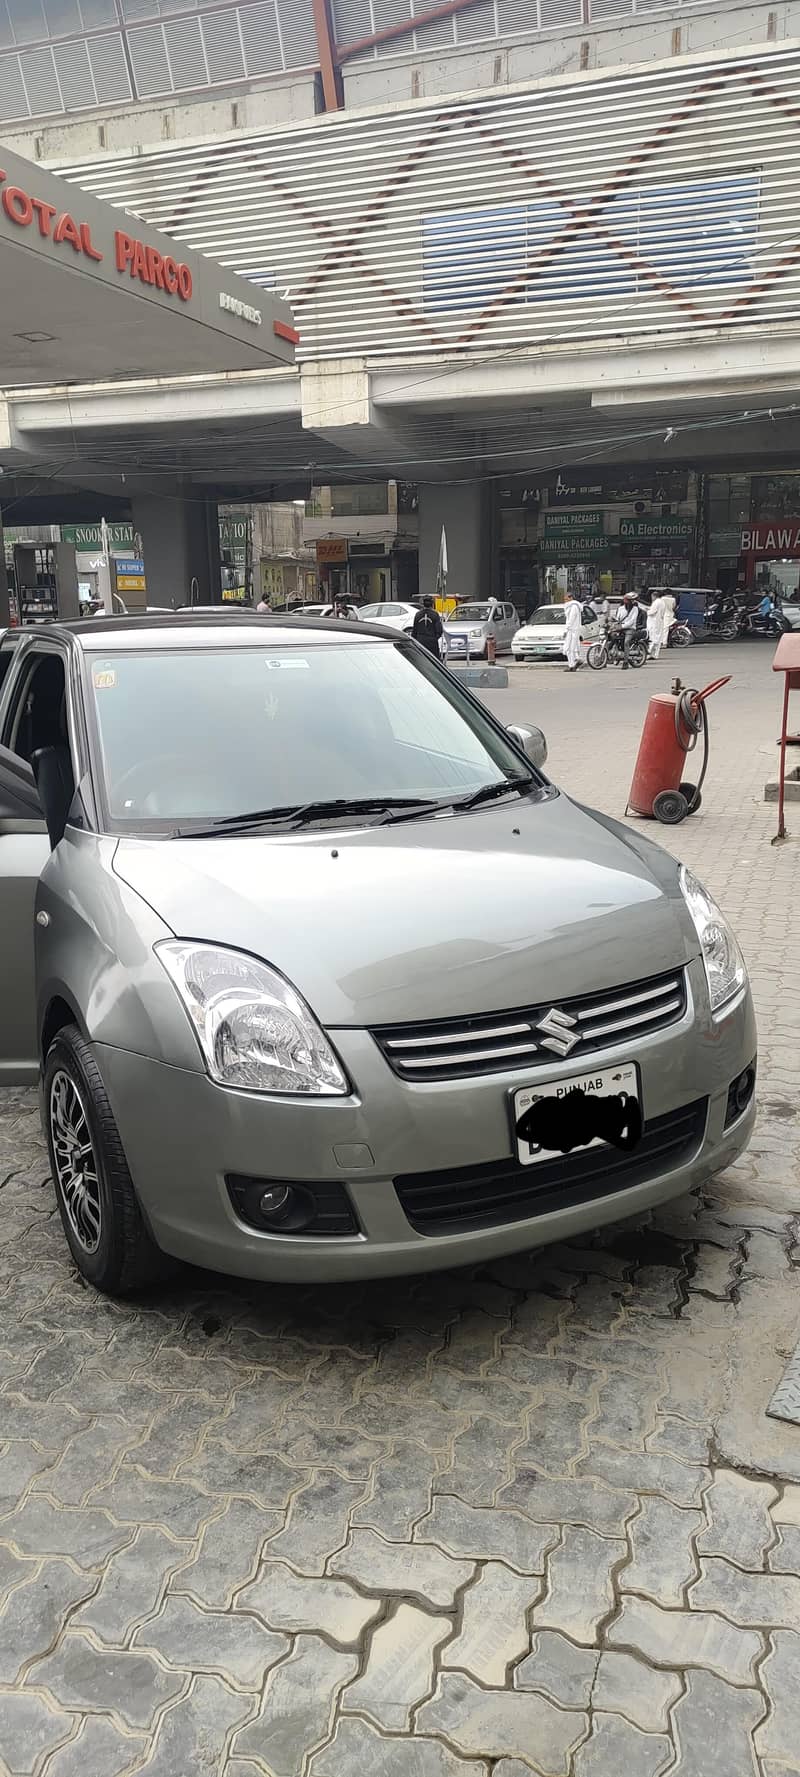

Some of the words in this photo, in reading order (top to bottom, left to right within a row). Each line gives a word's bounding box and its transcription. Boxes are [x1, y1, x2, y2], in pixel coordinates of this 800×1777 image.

[0, 168, 103, 261] OTAL
[115, 229, 193, 301] PARCO
[570, 513, 600, 525] PACKAGES
[76, 527, 113, 542] SNOOKR
[620, 523, 634, 535] QA
[637, 522, 693, 535] Electronics
[571, 537, 609, 550] PACKAGES
